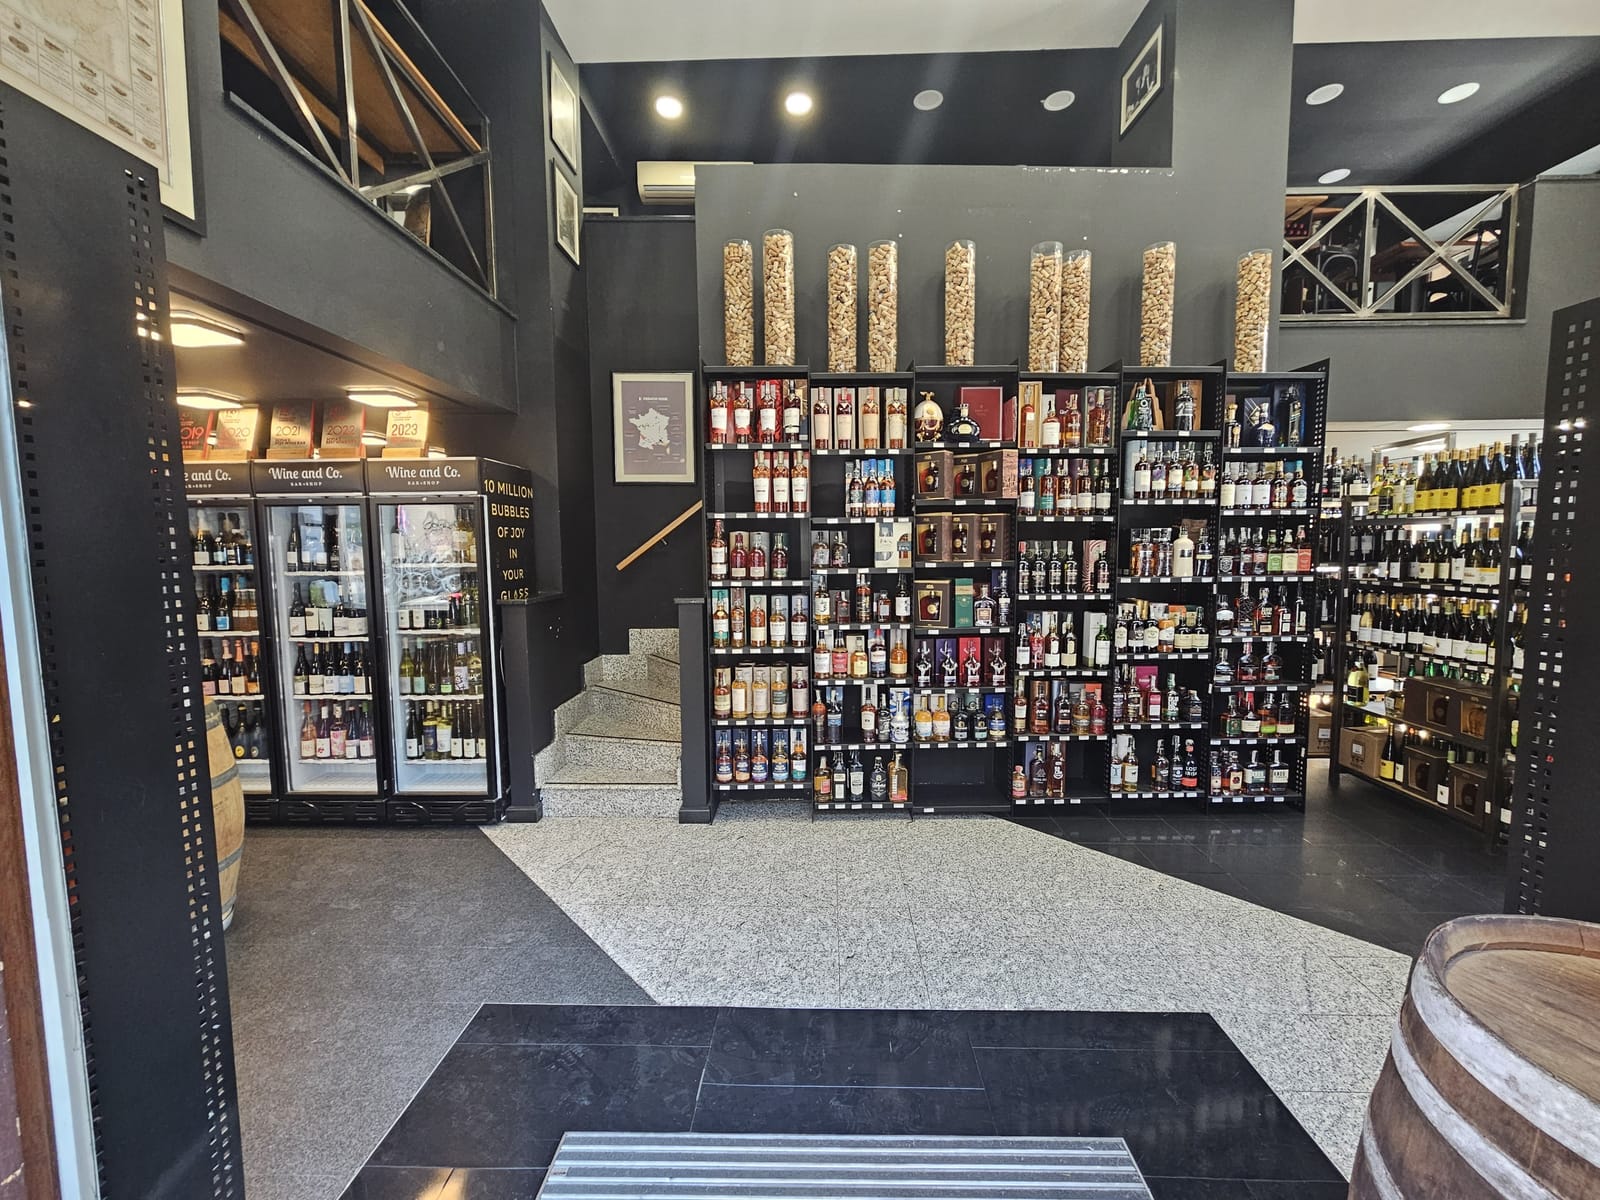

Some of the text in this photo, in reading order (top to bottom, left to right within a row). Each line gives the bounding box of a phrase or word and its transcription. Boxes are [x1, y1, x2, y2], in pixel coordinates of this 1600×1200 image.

[275, 425, 301, 437] 2021
[327, 424, 355, 436] 2022
[391, 423, 418, 436] 2023
[191, 469, 212, 481] and
[215, 469, 231, 481] Co.
[268, 466, 343, 480] Wine and Co.
[385, 465, 461, 479] Wine and Co.
[484, 479, 533, 498] 10 MILLION
[491, 503, 530, 519] BUBBLES
[497, 526, 526, 538] OF JOY
[509, 548, 518, 559] IN
[502, 569, 524, 580] YOUR
